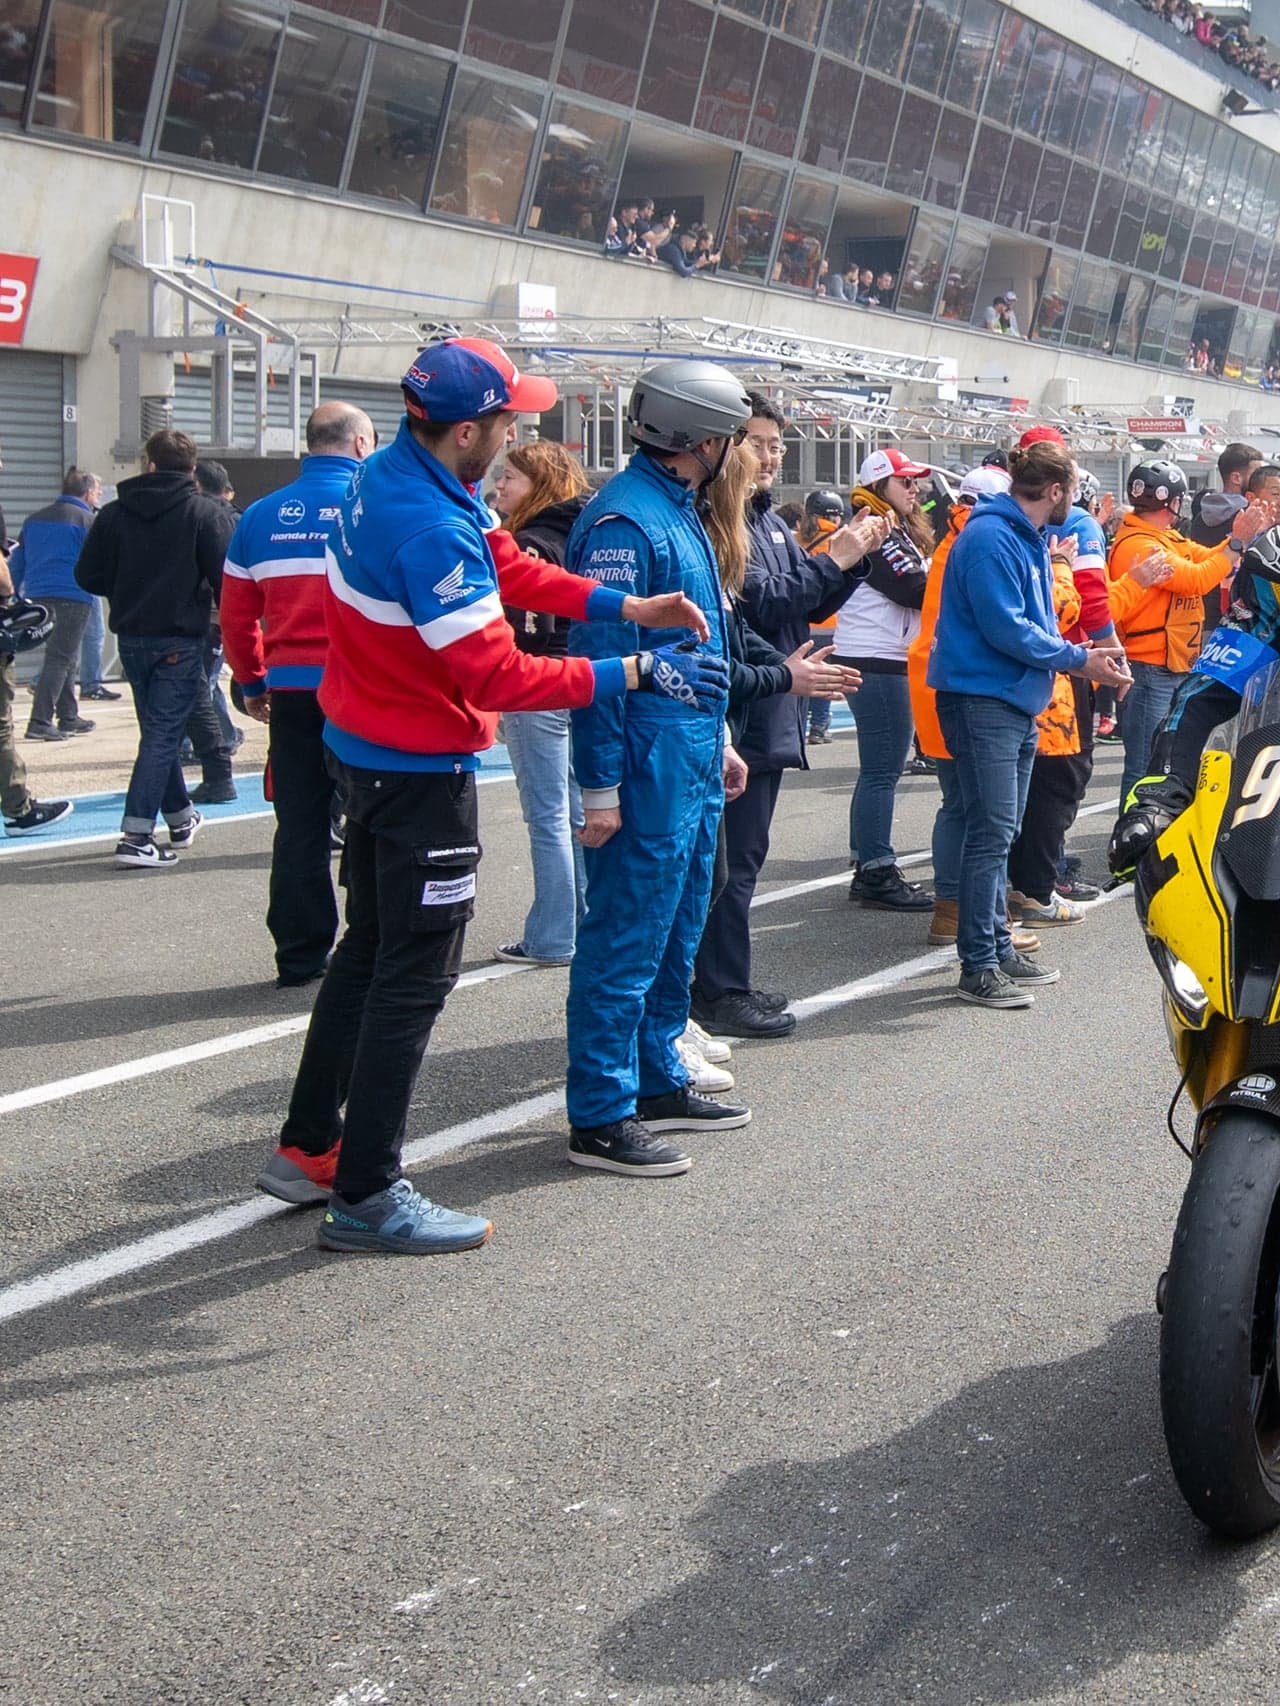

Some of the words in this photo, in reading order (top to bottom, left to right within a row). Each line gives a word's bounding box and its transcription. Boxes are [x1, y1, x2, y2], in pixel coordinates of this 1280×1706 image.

[66, 408, 74, 420] 8
[1130, 420, 1183, 428] CHAMPION
[270, 531, 306, 541] Honda
[308, 531, 329, 540] Fra
[589, 549, 637, 562] ACCUEIL
[584, 562, 639, 582] CONTRÔLE
[439, 586, 477, 605] HONDA
[1230, 1090, 1268, 1102] PITBULL
